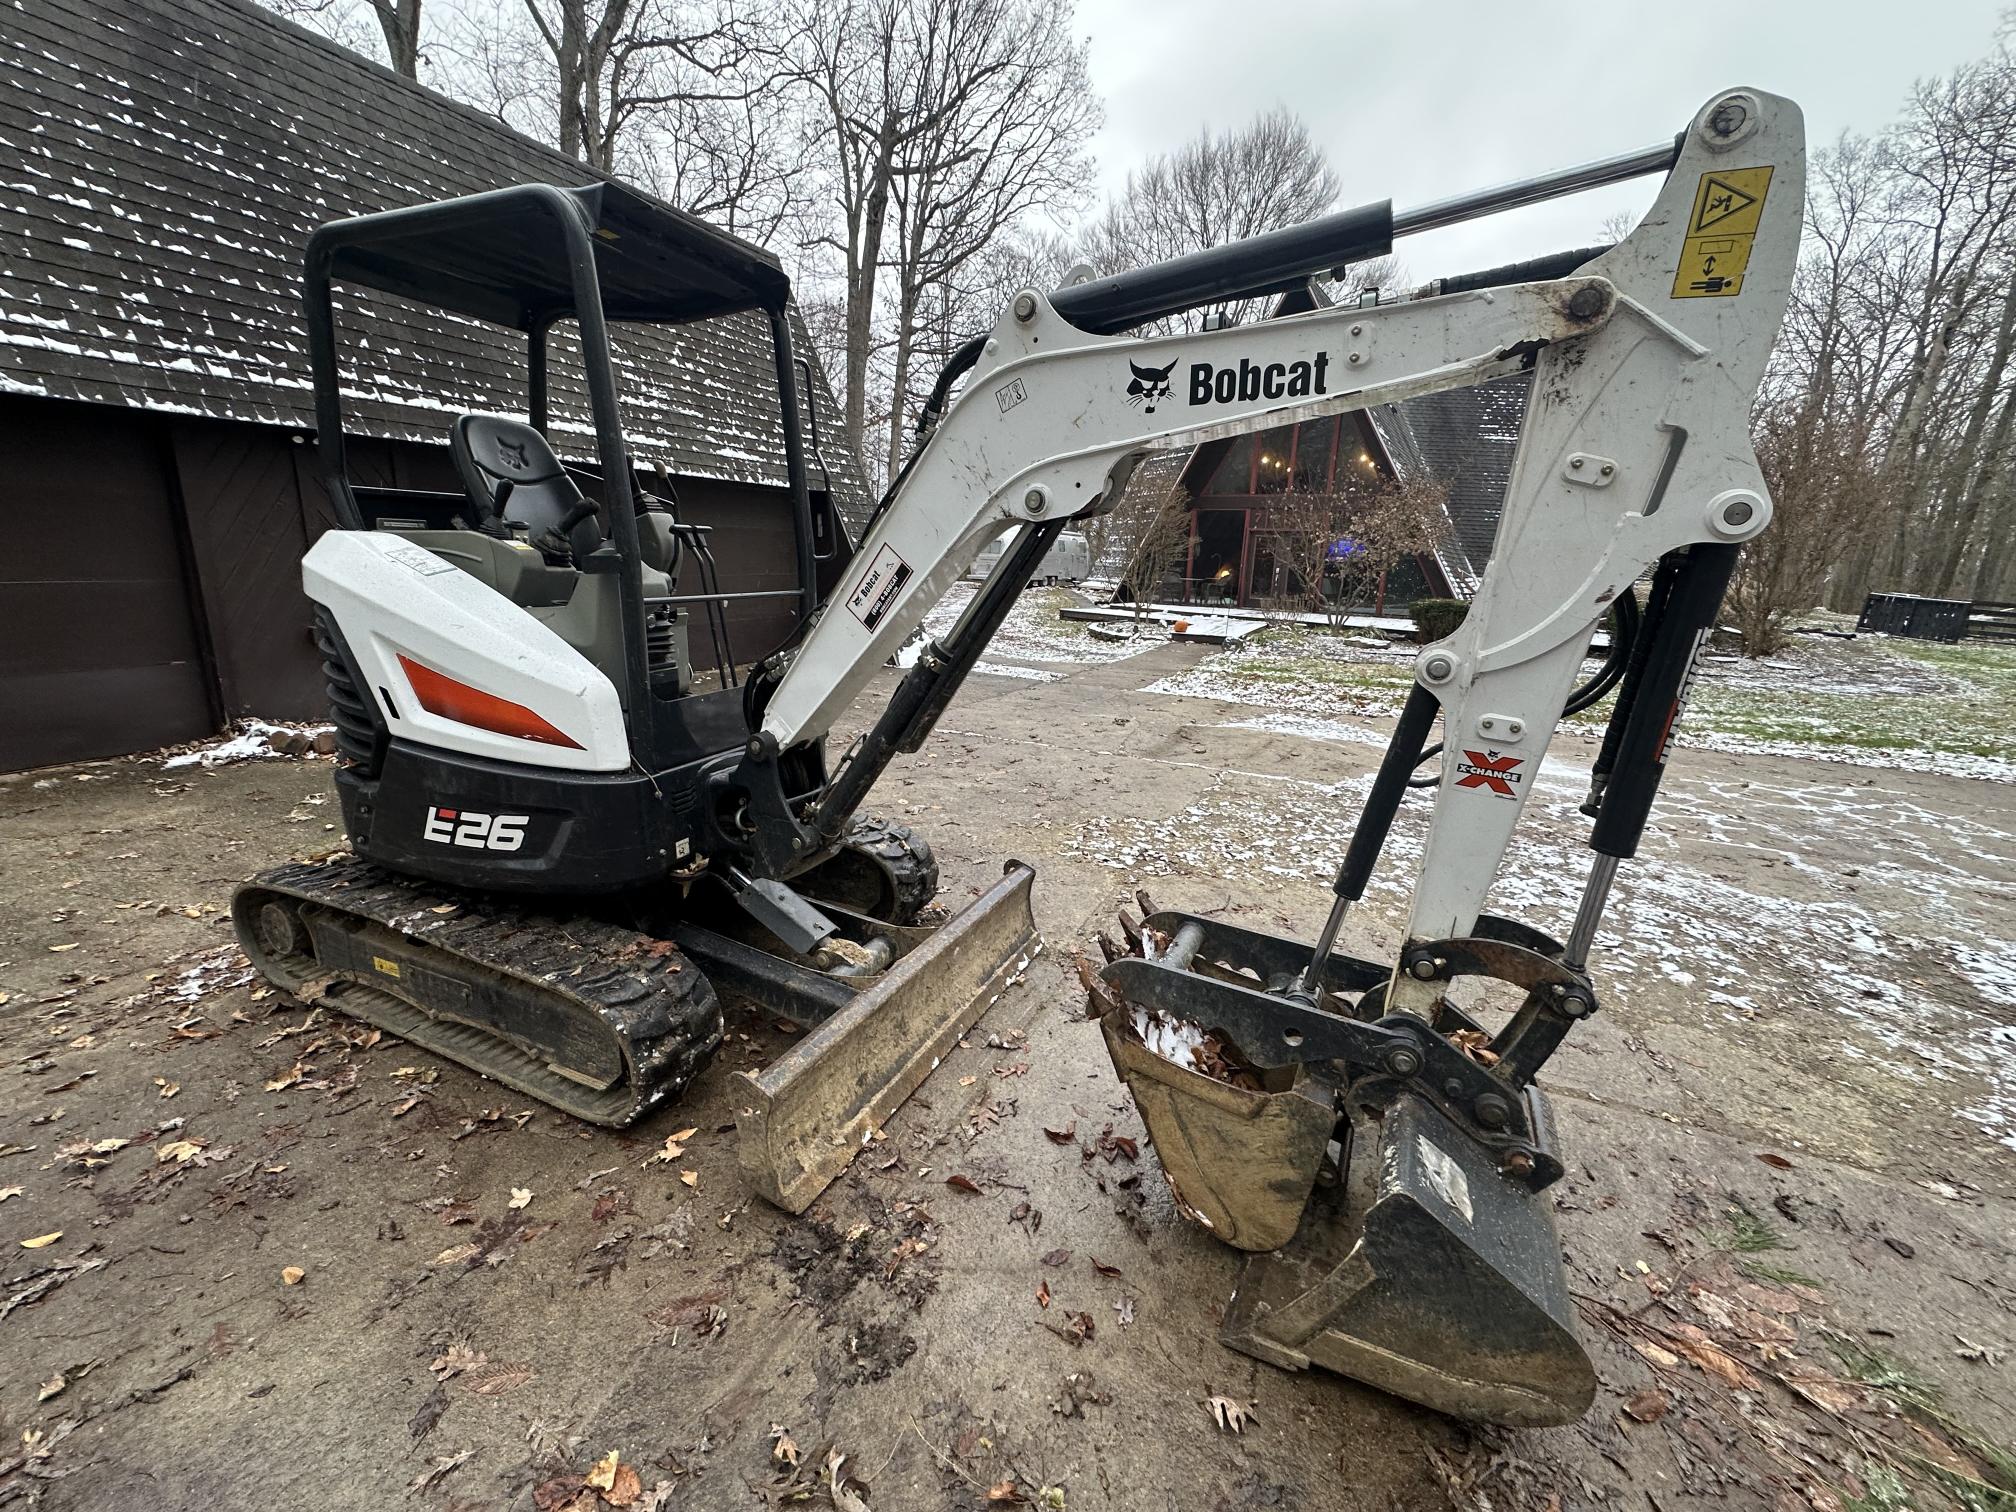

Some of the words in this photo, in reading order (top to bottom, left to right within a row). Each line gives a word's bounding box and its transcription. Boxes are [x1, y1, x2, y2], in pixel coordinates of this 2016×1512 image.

[1189, 351, 1329, 406] Bobcat
[860, 570, 881, 597] Bobcat
[880, 574, 899, 601] 4-BOBCAT
[1459, 764, 1519, 781] X-CHANGE
[423, 806, 530, 851] E26
